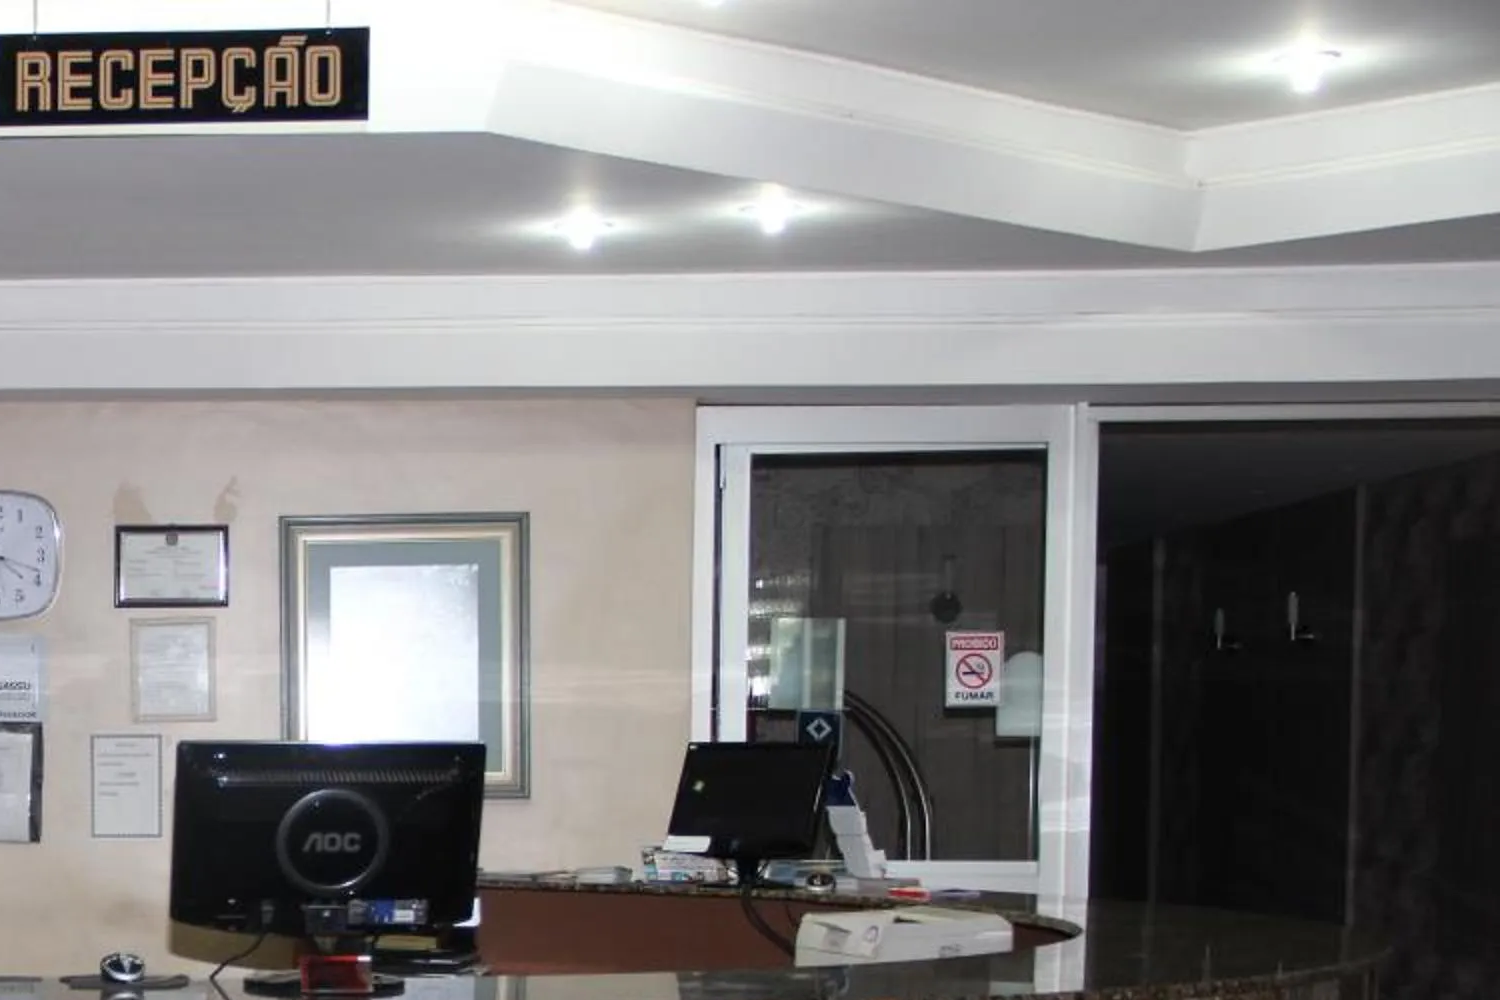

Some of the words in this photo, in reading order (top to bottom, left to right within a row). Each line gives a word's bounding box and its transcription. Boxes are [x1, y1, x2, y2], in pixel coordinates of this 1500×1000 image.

[15, 35, 341, 113] RECEPÇÃO
[17, 509, 23, 523] 1
[35, 526, 44, 539] 2
[37, 547, 45, 563] 3
[34, 573, 42, 587] 4
[14, 588, 25, 603] 5
[955, 691, 994, 700] FUMAR
[303, 831, 362, 853] AOC
